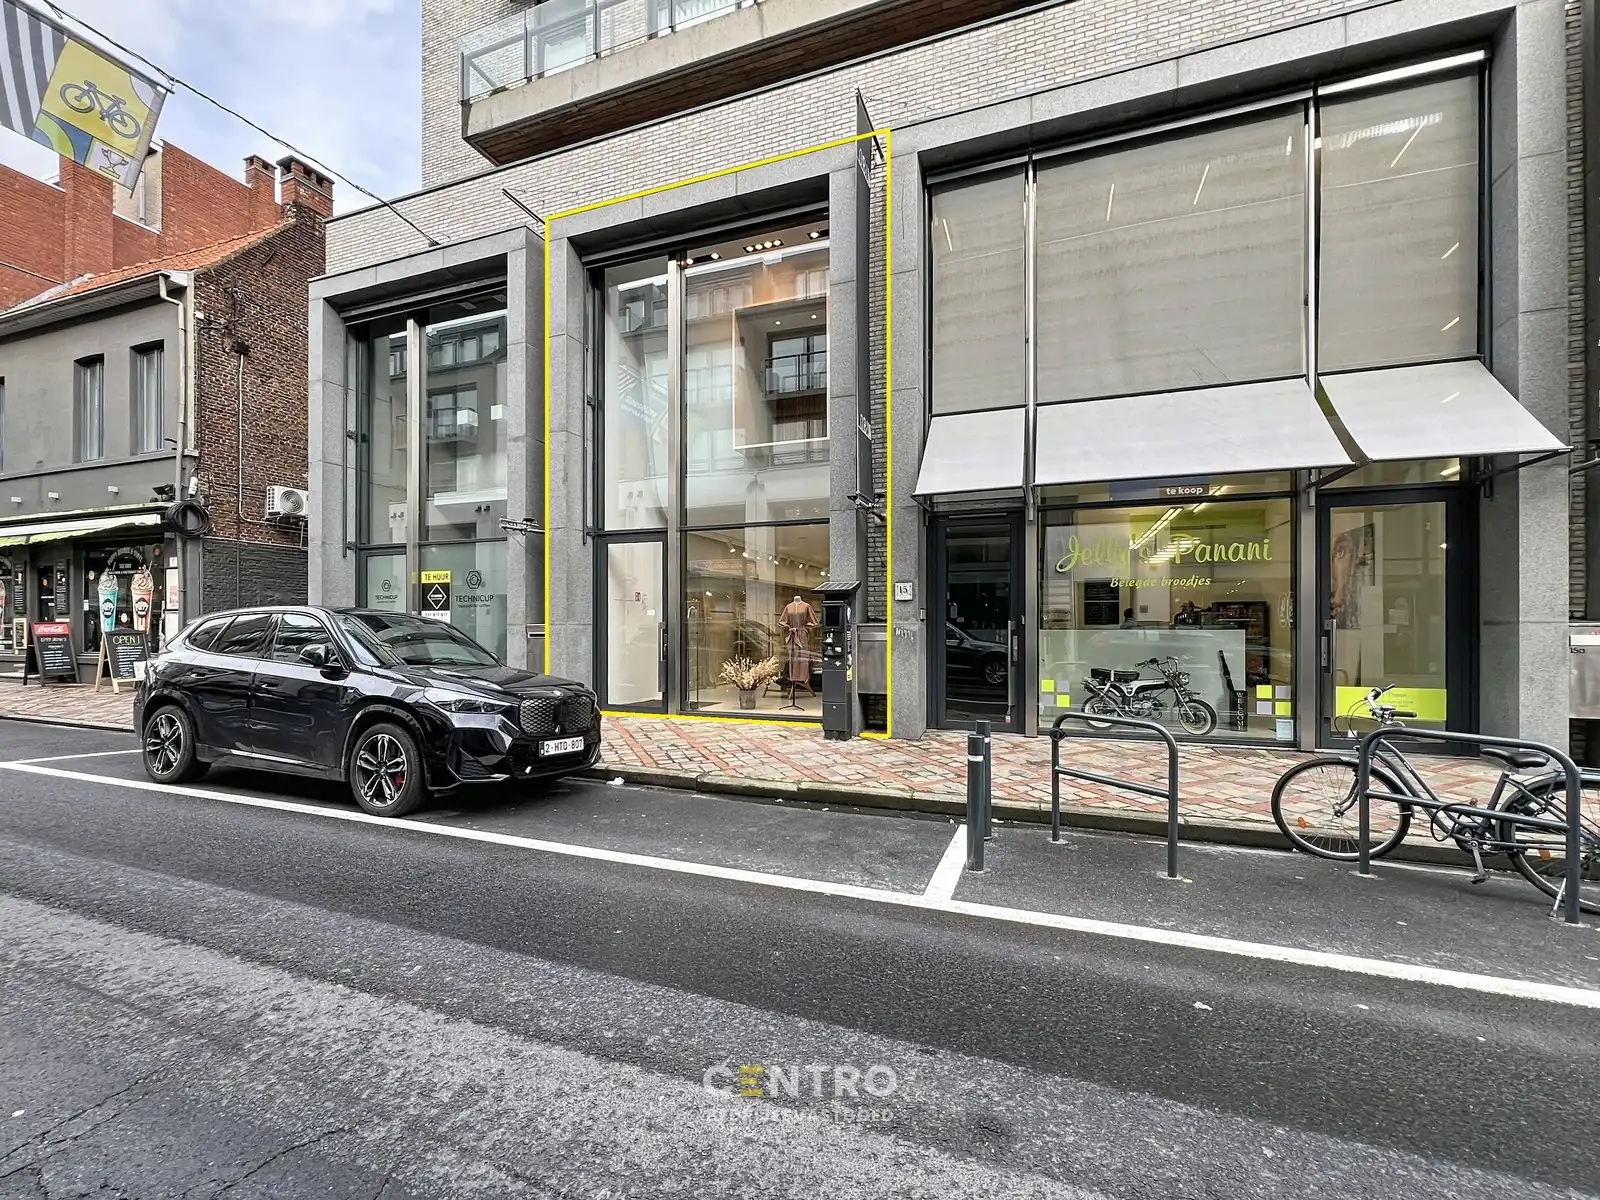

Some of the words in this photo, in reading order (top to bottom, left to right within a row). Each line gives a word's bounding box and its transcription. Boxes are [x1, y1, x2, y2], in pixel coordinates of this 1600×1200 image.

[1165, 486, 1177, 496] te
[1178, 485, 1203, 497] koop
[1170, 532, 1273, 565] Panani
[424, 573, 431, 581] TE
[432, 572, 449, 581] HUUR
[1160, 574, 1212, 590] broodjes
[898, 585, 908, 594] 15
[455, 594, 494, 603] TECHNICUP
